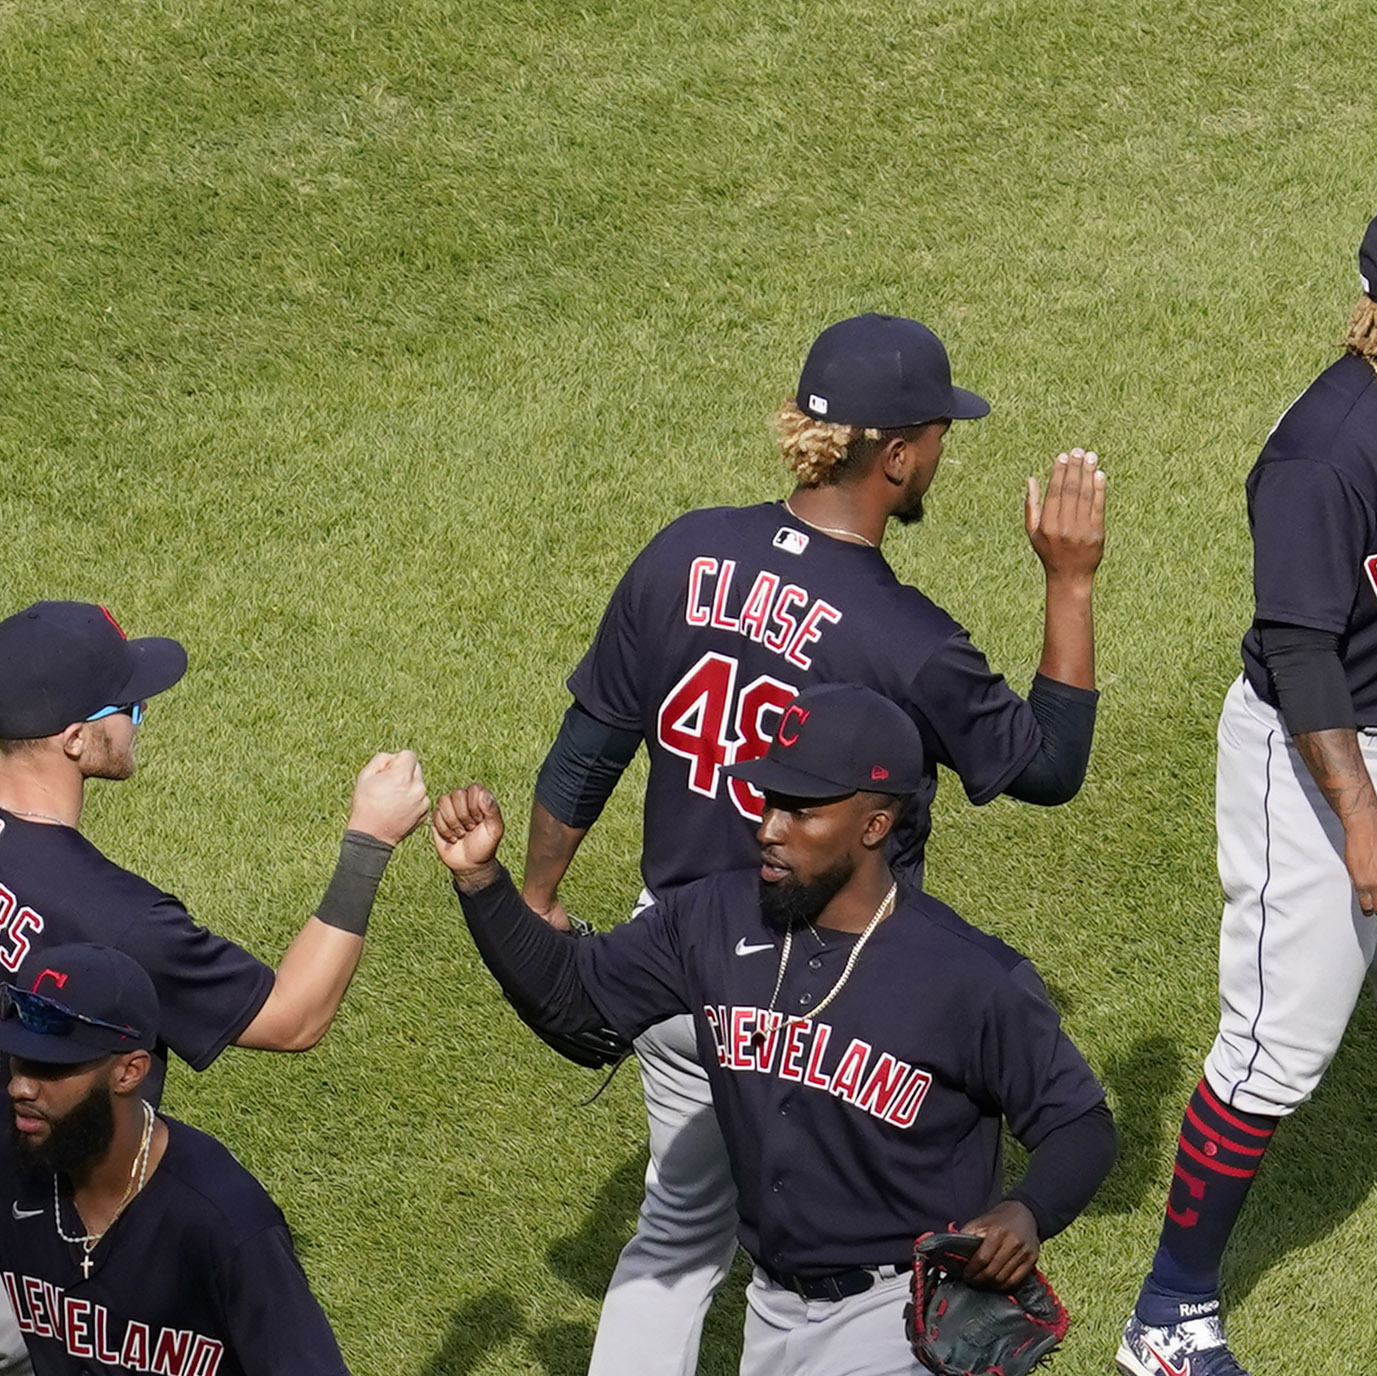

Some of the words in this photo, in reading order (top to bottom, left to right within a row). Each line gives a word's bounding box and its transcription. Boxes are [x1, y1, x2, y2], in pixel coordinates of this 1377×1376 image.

[685, 556, 843, 672] CLASE
[777, 704, 811, 747] C
[703, 1004, 933, 1130] CLEVELAND
